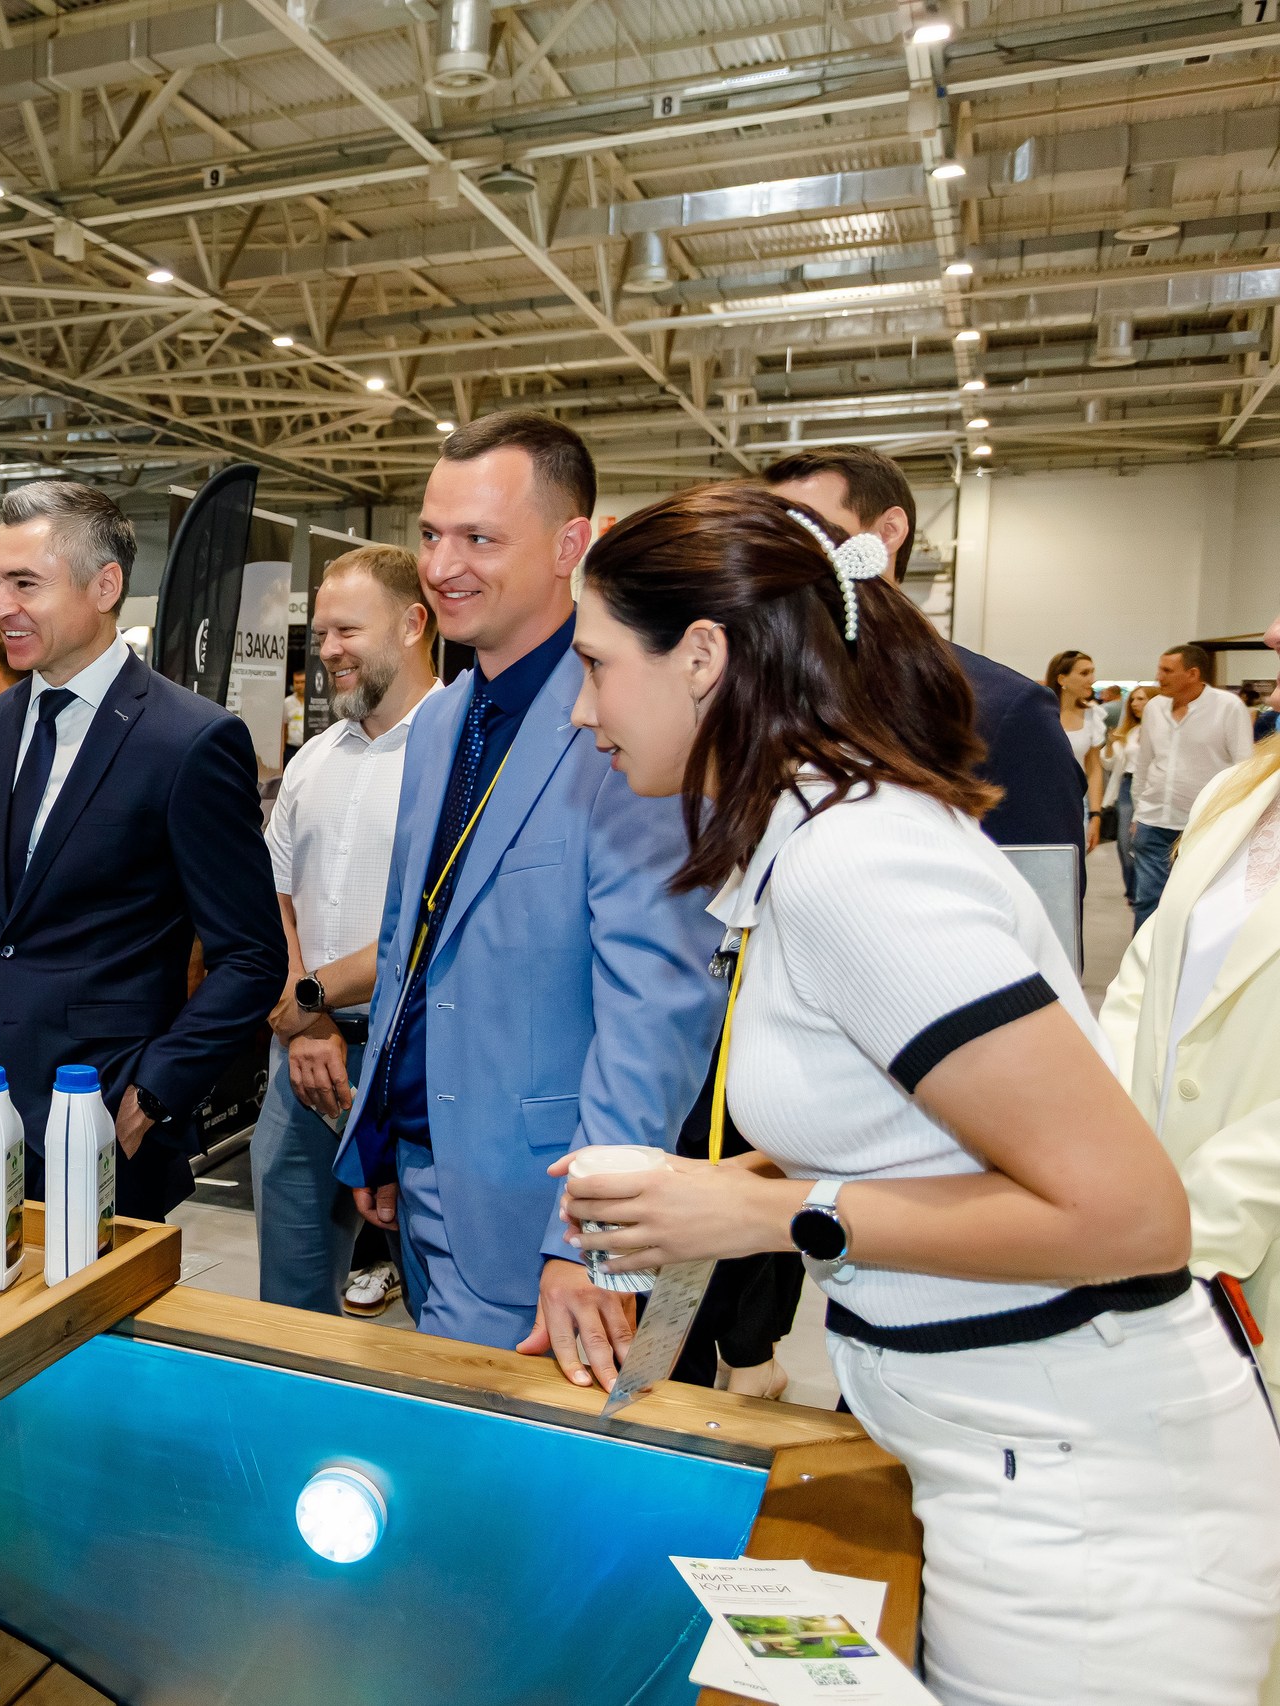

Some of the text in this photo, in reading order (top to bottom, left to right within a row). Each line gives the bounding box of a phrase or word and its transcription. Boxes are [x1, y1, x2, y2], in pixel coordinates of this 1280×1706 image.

[1254, 0, 1268, 23] 7
[662, 96, 672, 115] 8
[210, 169, 220, 186] 9
[245, 631, 286, 660] ЗАКАЗ
[691, 1571, 733, 1582] МИР
[699, 1582, 792, 1594] КУПЕЛЕЙ
